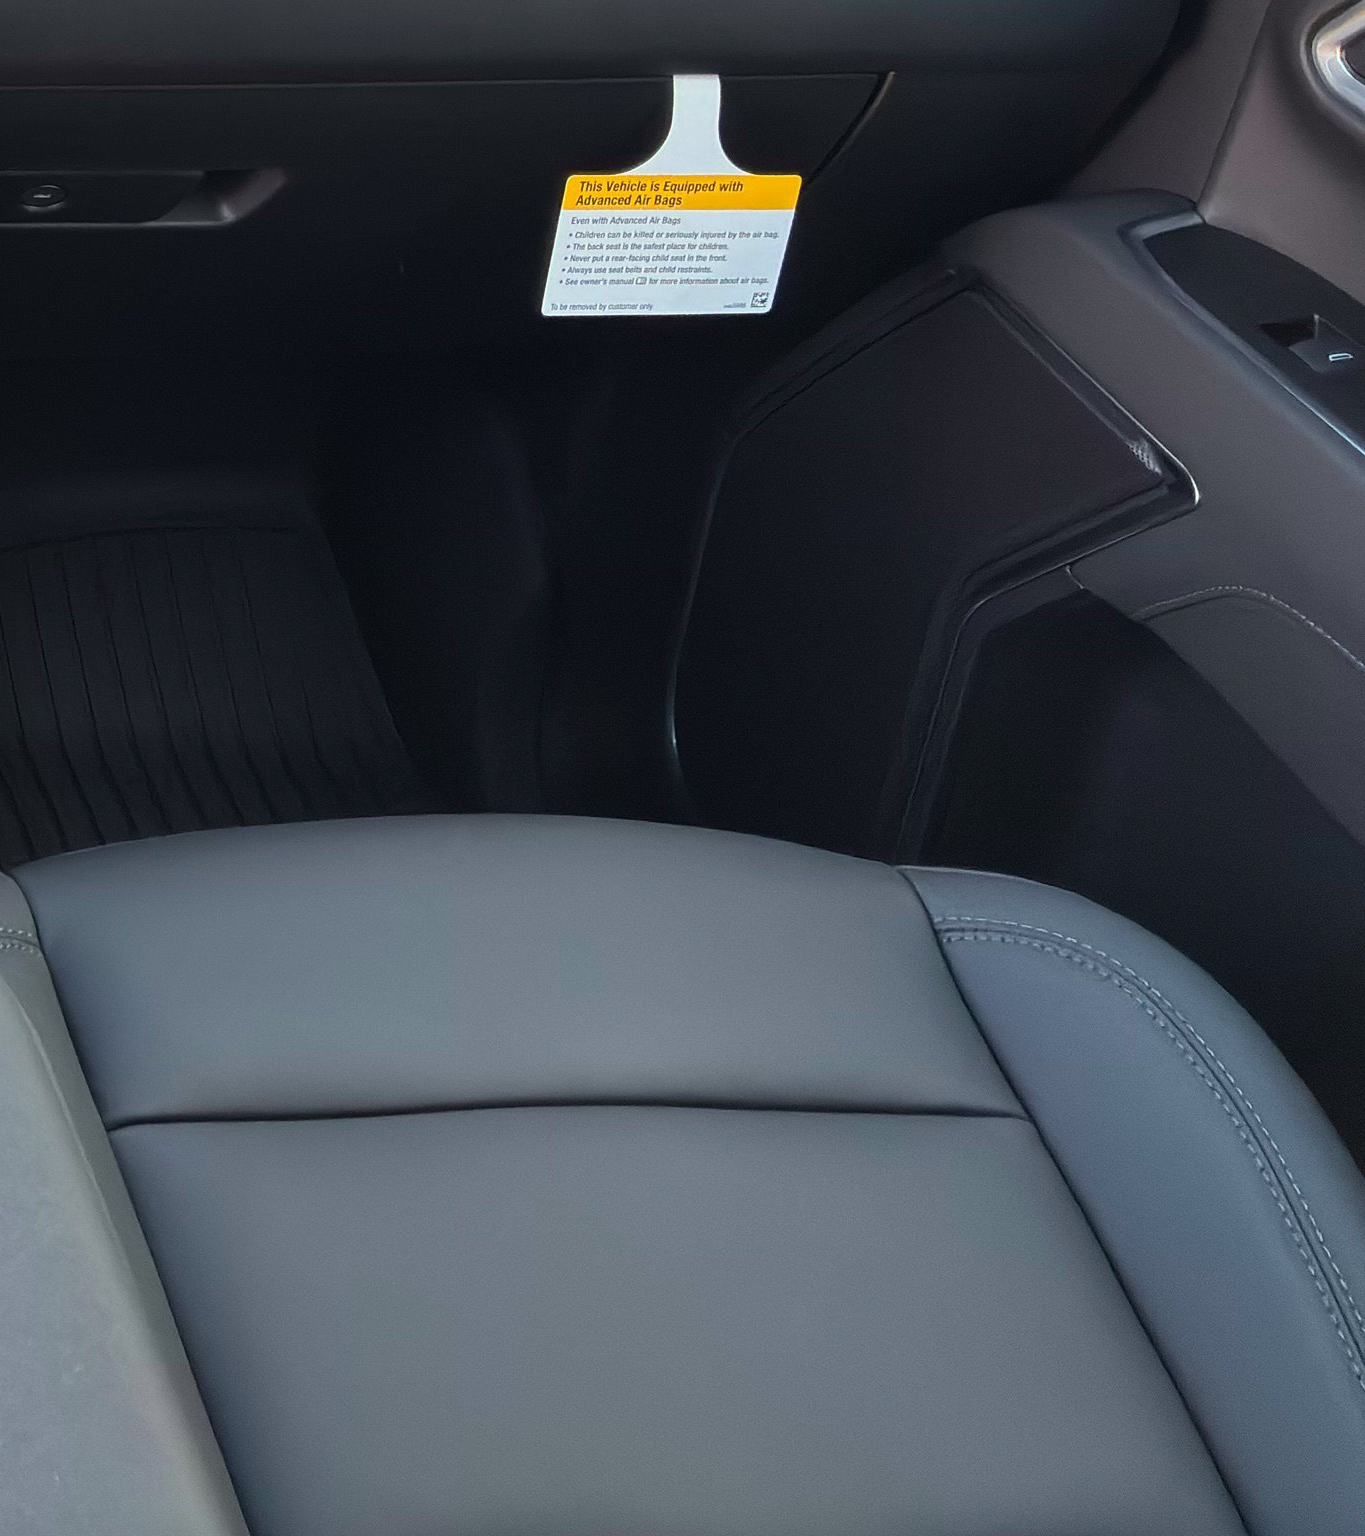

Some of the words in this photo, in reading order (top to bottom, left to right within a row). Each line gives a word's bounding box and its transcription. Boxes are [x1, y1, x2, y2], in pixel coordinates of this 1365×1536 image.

[580, 180, 604, 192] This
[606, 180, 648, 192] Vehicle
[649, 180, 661, 192] is
[662, 180, 717, 194] Equipped
[718, 180, 744, 192] with
[575, 194, 633, 206] Advanced
[634, 194, 652, 206] Air
[653, 194, 683, 208] Bags
[570, 216, 590, 225] Even
[591, 216, 609, 225] with
[609, 216, 649, 225] Advanced
[649, 216, 661, 225] Air
[661, 216, 682, 226] Bags
[574, 230, 606, 239] Children
[607, 231, 622, 239] can
[622, 230, 633, 239] be
[633, 230, 655, 239] killed
[665, 230, 700, 240] seriously
[700, 230, 727, 240] injured
[727, 231, 738, 240] by
[738, 230, 751, 239] the
[752, 230, 763, 238] air
[572, 242, 586, 251] The
[587, 242, 604, 251] back
[605, 243, 622, 251] seat
[622, 242, 629, 251] is
[630, 242, 643, 251] the
[643, 242, 665, 251] safest
[665, 242, 686, 251] place
[687, 242, 698, 251] for
[569, 254, 591, 263] Never
[591, 255, 605, 264] put
[611, 254, 651, 264] rear-facing
[651, 254, 670, 263] child
[670, 254, 687, 262] seat
[687, 254, 695, 262] in
[695, 254, 708, 262] the
[567, 266, 593, 276] Always
[608, 266, 624, 274] seat
[643, 266, 658, 274] and
[658, 266, 676, 274] child
[564, 278, 578, 286] See
[579, 277, 608, 285] owner's
[608, 277, 635, 285] manual
[648, 277, 659, 285] for
[679, 277, 719, 285] information
[719, 277, 740, 285] about
[550, 303, 559, 311] To
[559, 303, 568, 311] be
[569, 303, 598, 311] removed
[598, 303, 607, 312] by
[608, 303, 639, 311] customer
[639, 303, 654, 312] only
